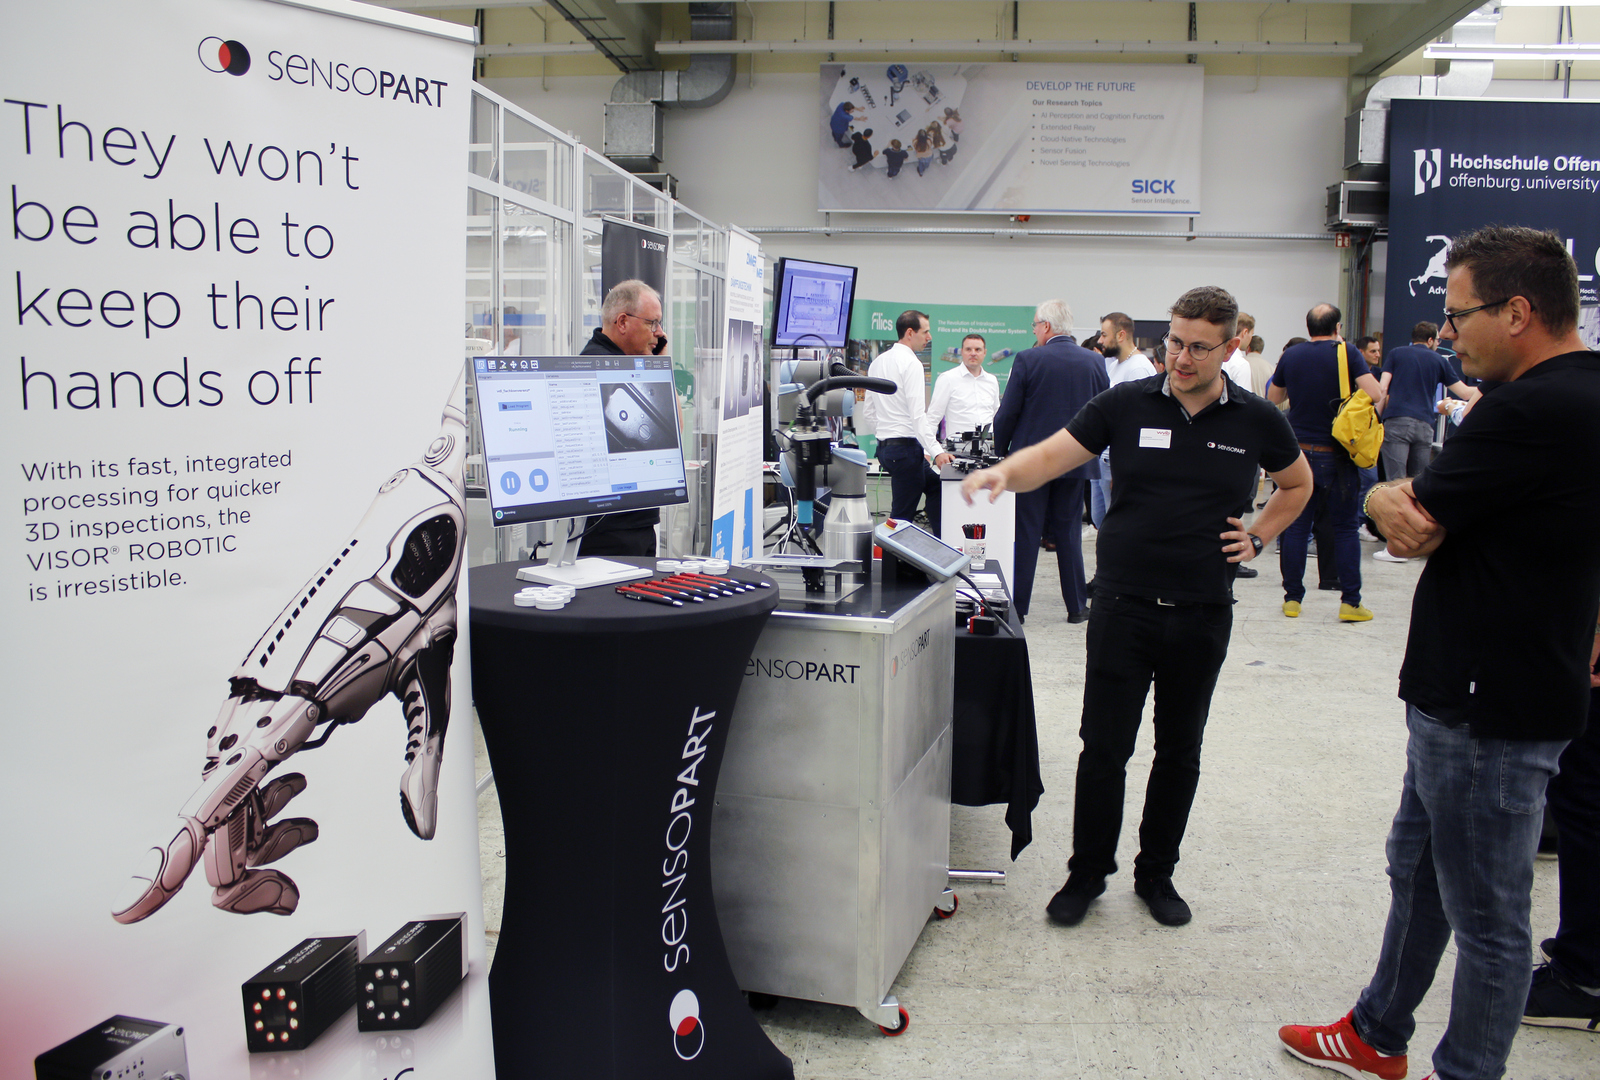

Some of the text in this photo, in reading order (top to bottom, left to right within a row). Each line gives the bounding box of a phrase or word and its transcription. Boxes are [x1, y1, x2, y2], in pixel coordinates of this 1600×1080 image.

[1026, 81, 1136, 92] DEVELOP THE FUTURE
[1081, 100, 1103, 108] Topics
[4, 98, 176, 180] They
[1073, 124, 1096, 132] Reality
[1084, 136, 1126, 144] Technologies
[1060, 159, 1086, 167] Sensing
[1088, 160, 1130, 168] Technologies
[1450, 153, 1549, 171] Hochschule
[1131, 179, 1176, 194] SICK
[1449, 173, 1600, 193] offenburg.university
[12, 184, 334, 259] be able to
[16, 271, 335, 339] keep their
[872, 312, 893, 331] Filics
[21, 356, 322, 411] hands off
[21, 450, 291, 481] With its fast, integrated
[24, 478, 281, 516] processing for quicker
[25, 507, 251, 542] 3D inspections, the
[129, 534, 237, 561] ROBOTIC
[29, 569, 187, 601] is irresistible.
